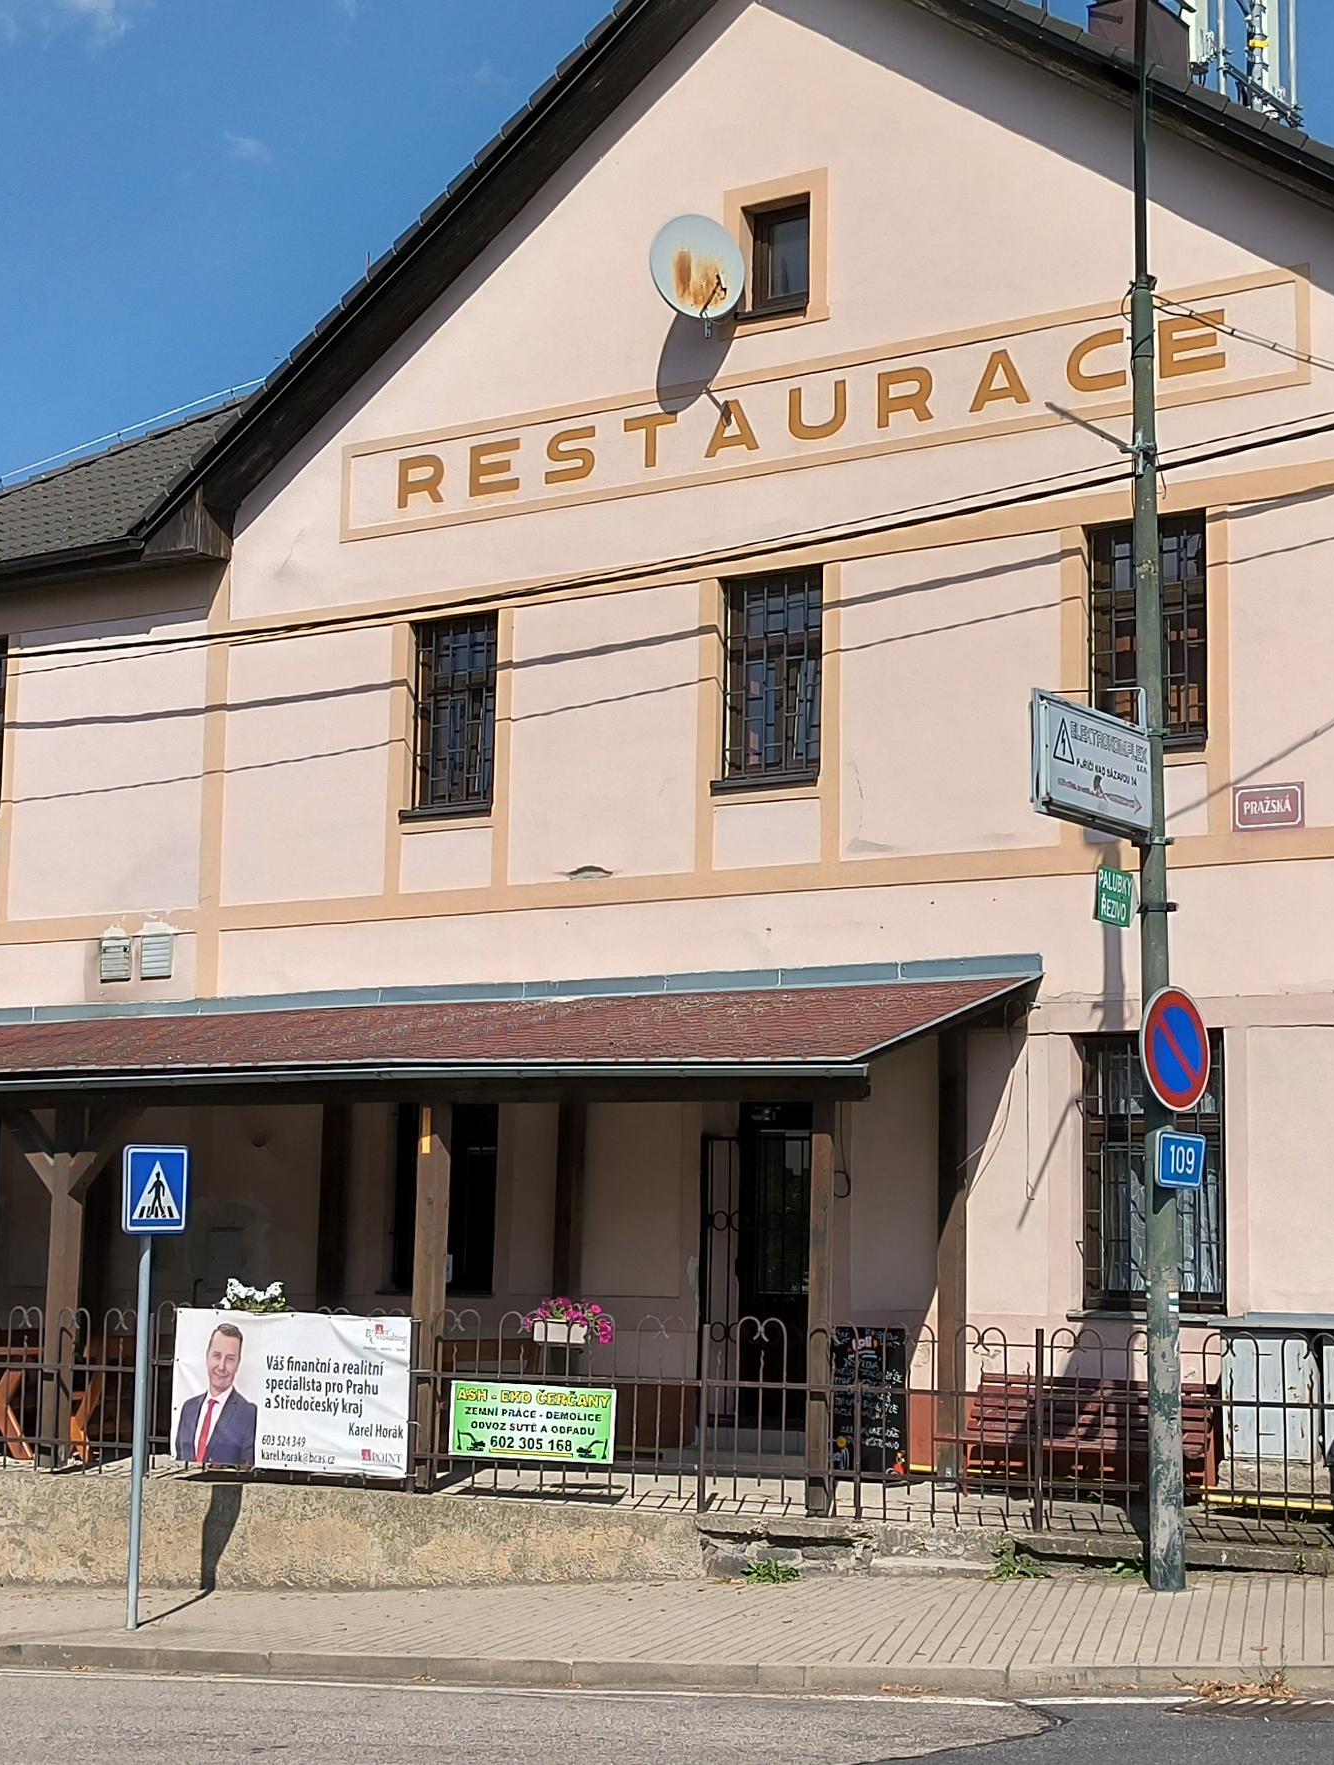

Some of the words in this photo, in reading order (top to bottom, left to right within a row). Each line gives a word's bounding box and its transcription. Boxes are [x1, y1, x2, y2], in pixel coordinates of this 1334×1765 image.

[396, 308, 1227, 510] RESTAURACE
[1094, 762, 1106, 776] NAD
[1243, 794, 1292, 815] PRAŽSKÁ
[1098, 869, 1132, 897] PALUBKY
[1101, 893, 1127, 921] ŘEZIVO
[1170, 1145, 1195, 1174] 109
[266, 1355, 284, 1371] Váš
[287, 1357, 331, 1373] finanční
[333, 1364, 339, 1373] a
[342, 1361, 384, 1376] realitní
[265, 1376, 322, 1393] specialista
[325, 1384, 343, 1396] pro
[346, 1379, 379, 1395] Prahu
[265, 1399, 271, 1409] a
[273, 1394, 339, 1416] Středočeský
[342, 1398, 363, 1418] kraj
[457, 1388, 488, 1402] ASH
[500, 1390, 532, 1403] EKO
[536, 1389, 611, 1408] ČERČANY
[465, 1406, 499, 1416] ZEMNÍ
[501, 1408, 536, 1418] PRÁCE
[546, 1411, 602, 1422] DEMOLICE
[348, 1422, 373, 1437] Karel
[375, 1424, 404, 1439] Horák
[471, 1421, 506, 1431] ODVOZ
[540, 1425, 547, 1433] A
[551, 1425, 595, 1435] ODPADU
[261, 1434, 275, 1446] 603
[490, 1436, 514, 1449] 602
[519, 1437, 543, 1450] 305
[548, 1439, 572, 1452] 168
